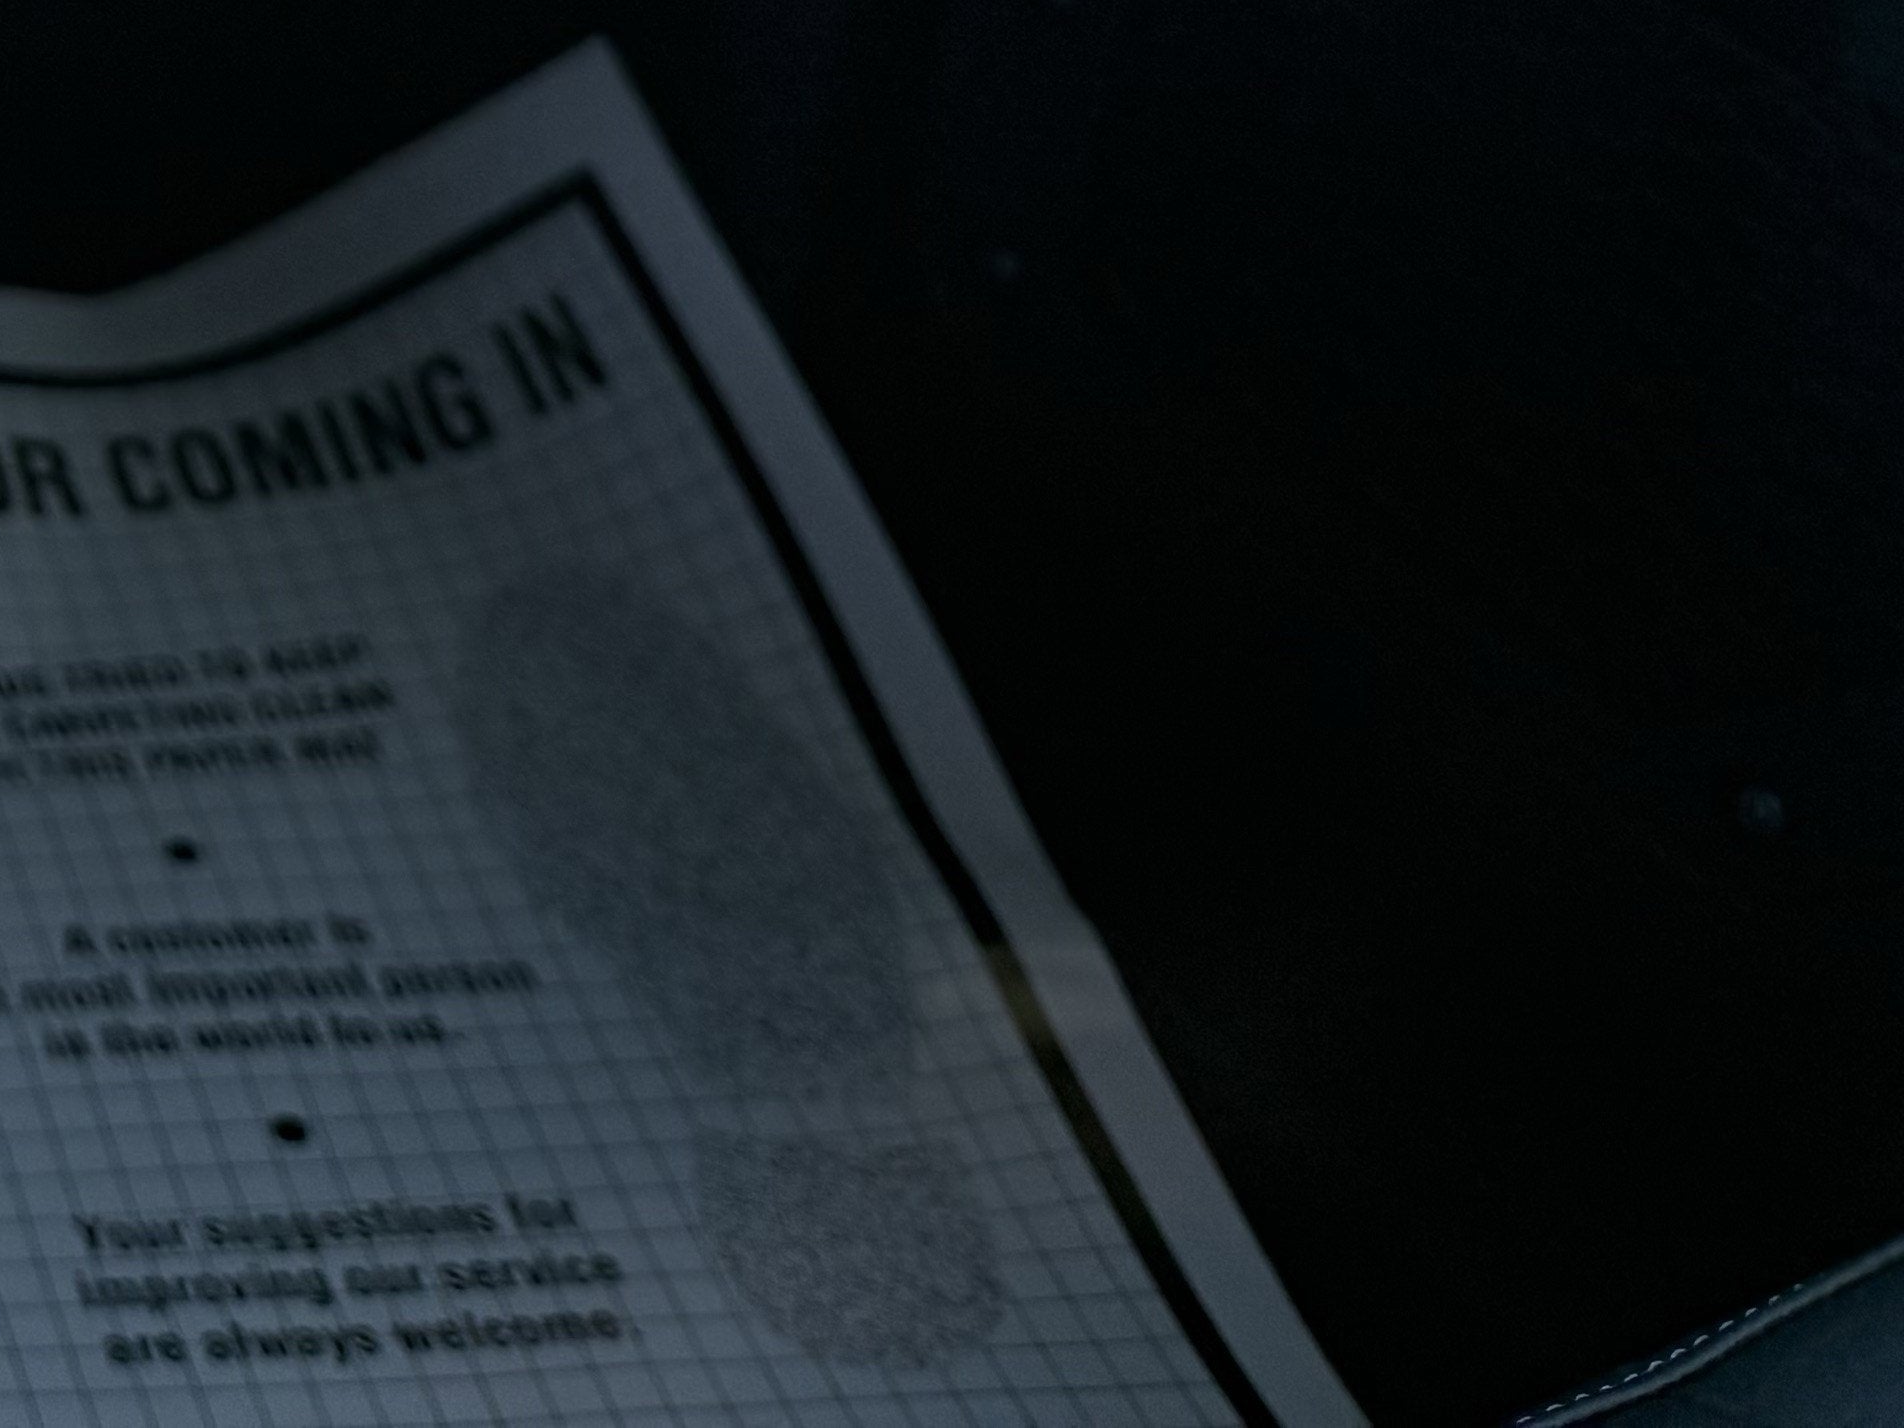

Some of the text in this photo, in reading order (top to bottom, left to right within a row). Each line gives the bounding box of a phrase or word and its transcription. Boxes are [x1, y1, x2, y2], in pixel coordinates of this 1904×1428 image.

[105, 353, 495, 511] COMING
[491, 292, 610, 418] IN
[74, 1211, 186, 1252] Your
[202, 1198, 496, 1251] suggestions
[439, 1249, 624, 1291] service
[104, 1331, 188, 1366] are
[201, 1320, 381, 1367] always
